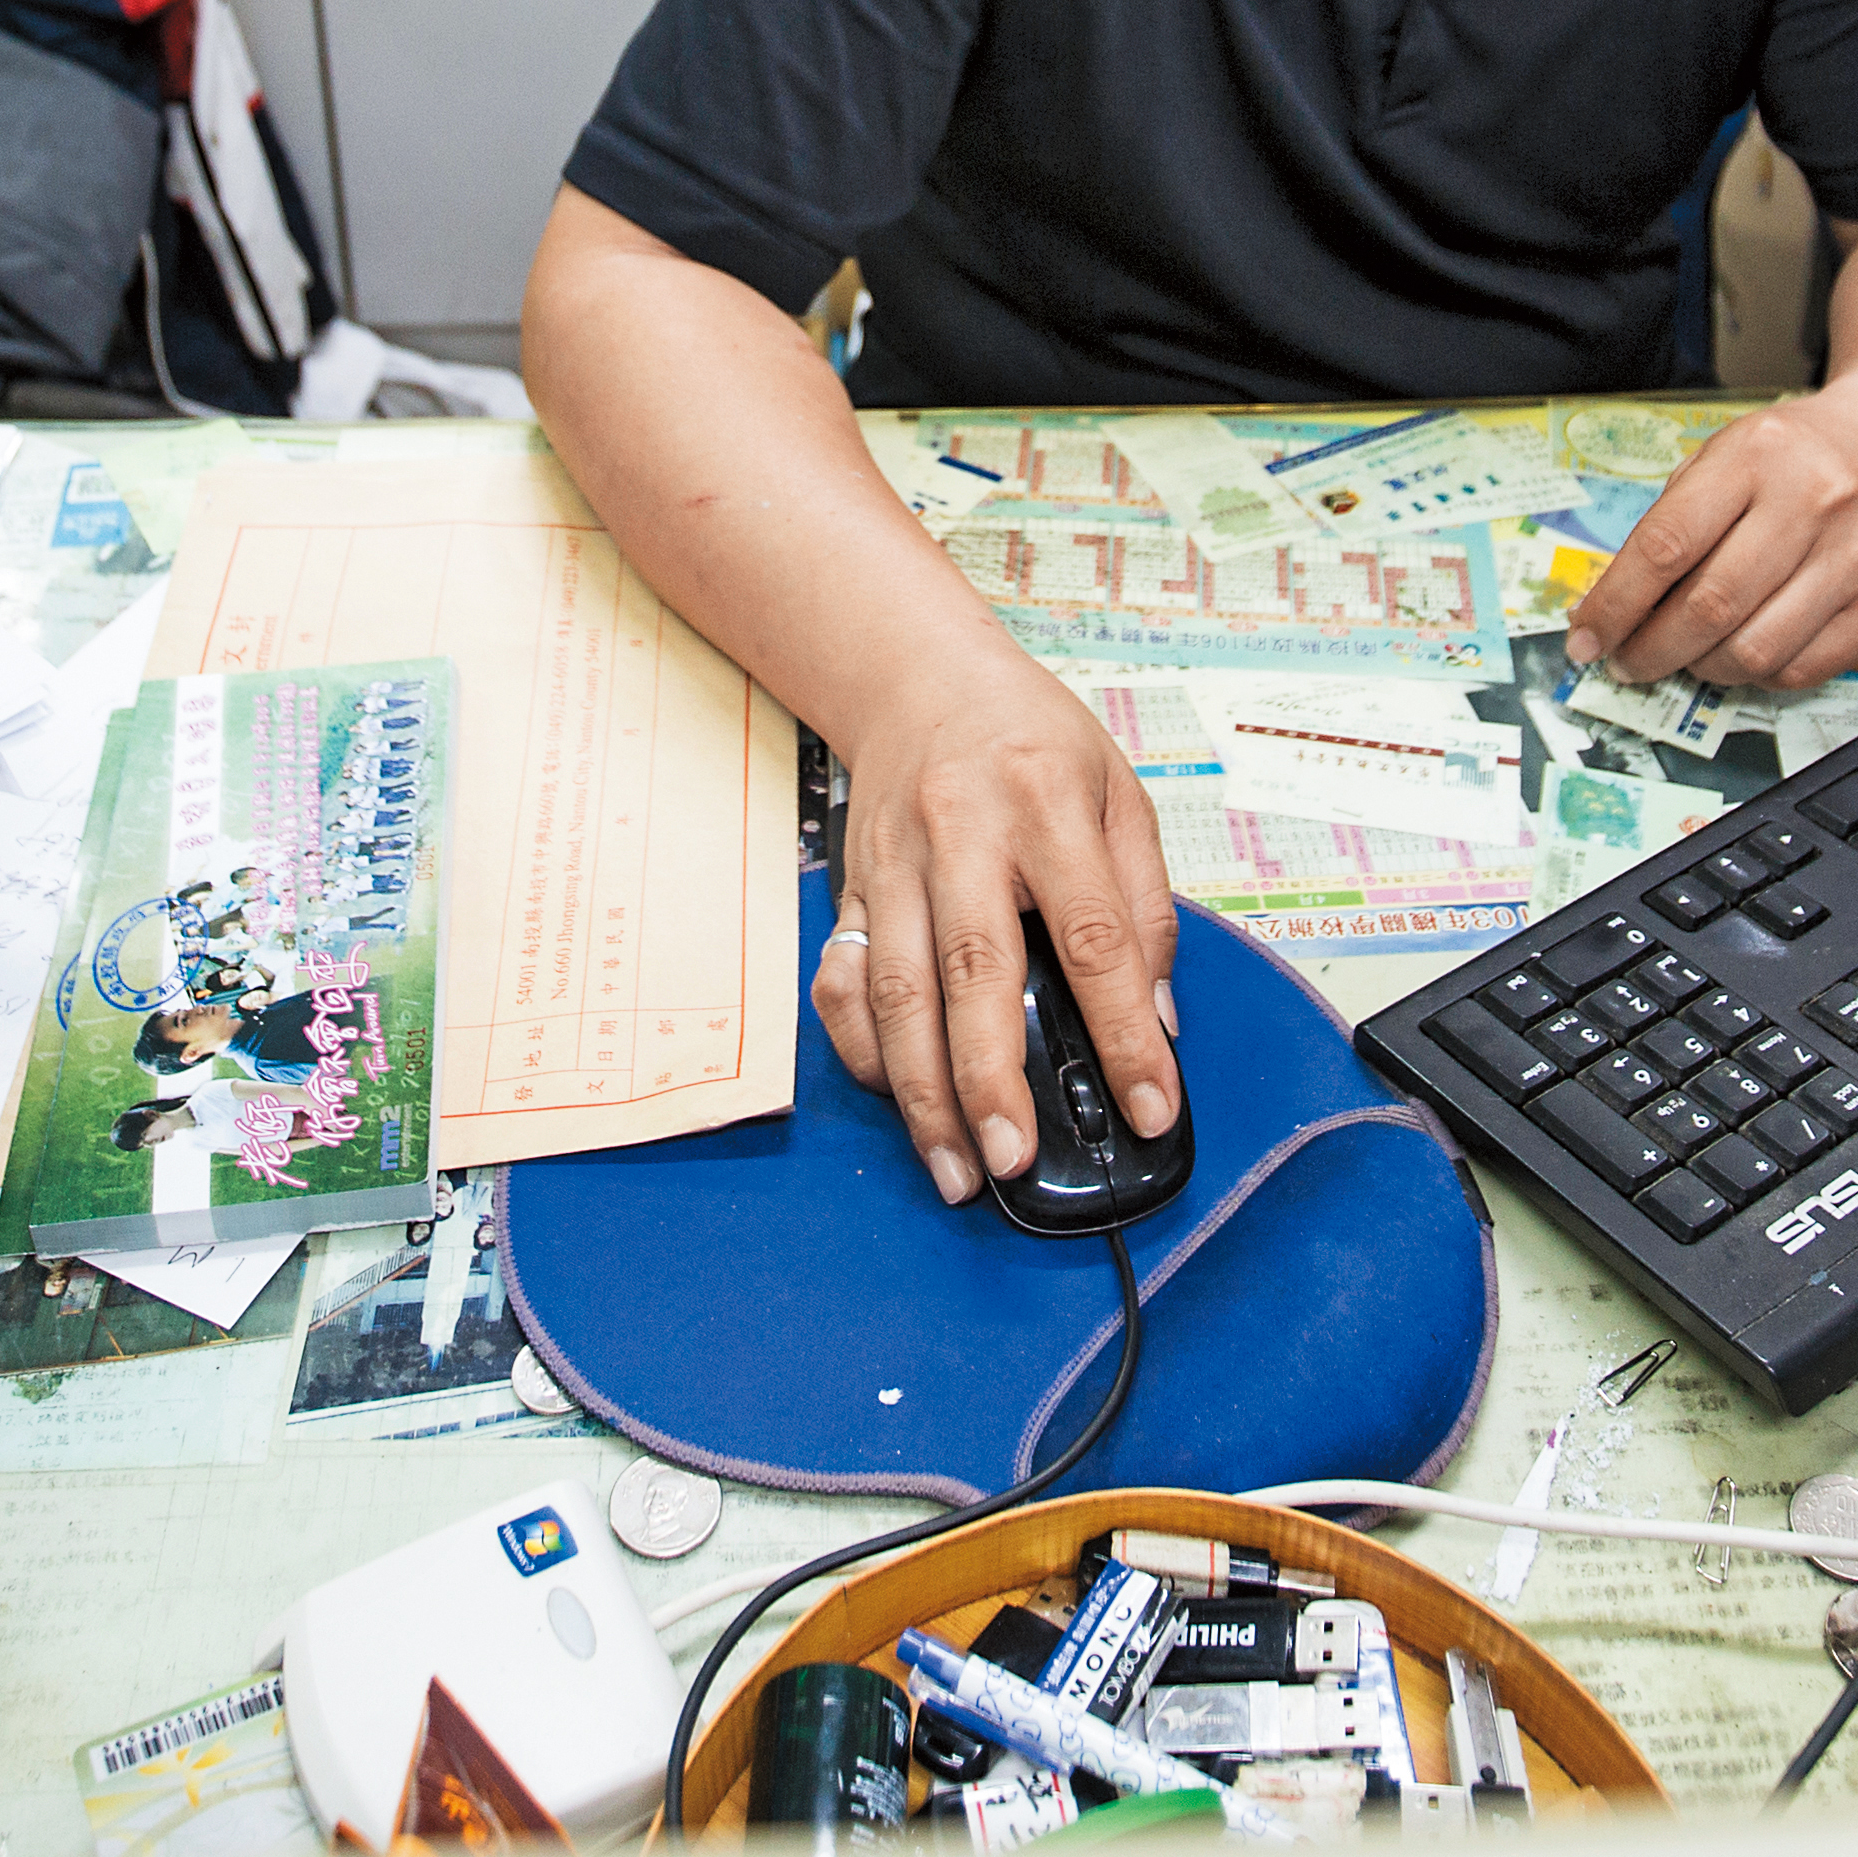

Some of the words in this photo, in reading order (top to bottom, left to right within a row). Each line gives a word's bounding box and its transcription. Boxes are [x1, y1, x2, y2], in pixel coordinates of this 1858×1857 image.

[585, 628, 602, 663] 54001
[581, 663, 602, 710] County
[577, 708, 594, 754] Nantou
[1456, 739, 1501, 752] GFC
[573, 754, 594, 787] City,
[568, 789, 587, 835] Nantou
[415, 845, 435, 881] 0501
[564, 836, 585, 875] Road,
[557, 875, 581, 943] Jhongsing
[1298, 892, 1329, 907] 4月
[1400, 888, 1430, 903] 3月
[600, 906, 626, 996] 中華民國
[1627, 930, 1645, 944] 0
[516, 965, 537, 1005] 54001
[551, 947, 573, 1001] No.660
[1506, 975, 1528, 990] Del
[1683, 969, 1700, 981] 1
[353, 992, 381, 1042] Around
[1631, 997, 1649, 1012] 2
[1732, 1008, 1751, 1022] 4
[296, 940, 370, 1148] 你會不會回來
[405, 1028, 427, 1073] 0501
[523, 1023, 545, 1068] 地址
[598, 1019, 618, 1062] 日期
[1580, 1028, 1600, 1043] 3
[1685, 1038, 1703, 1054] 5
[363, 1041, 390, 1083] Turn
[1521, 1061, 1550, 1081] Enter
[1794, 1047, 1812, 1064] 7
[1634, 1070, 1652, 1084] 6
[1741, 1079, 1760, 1094] 8
[1833, 1084, 1858, 1102] Lock
[380, 1105, 401, 1172] mm2
[1692, 1113, 1710, 1129] 9
[236, 1092, 309, 1189] 老師
[501, 1523, 532, 1565] Windows
